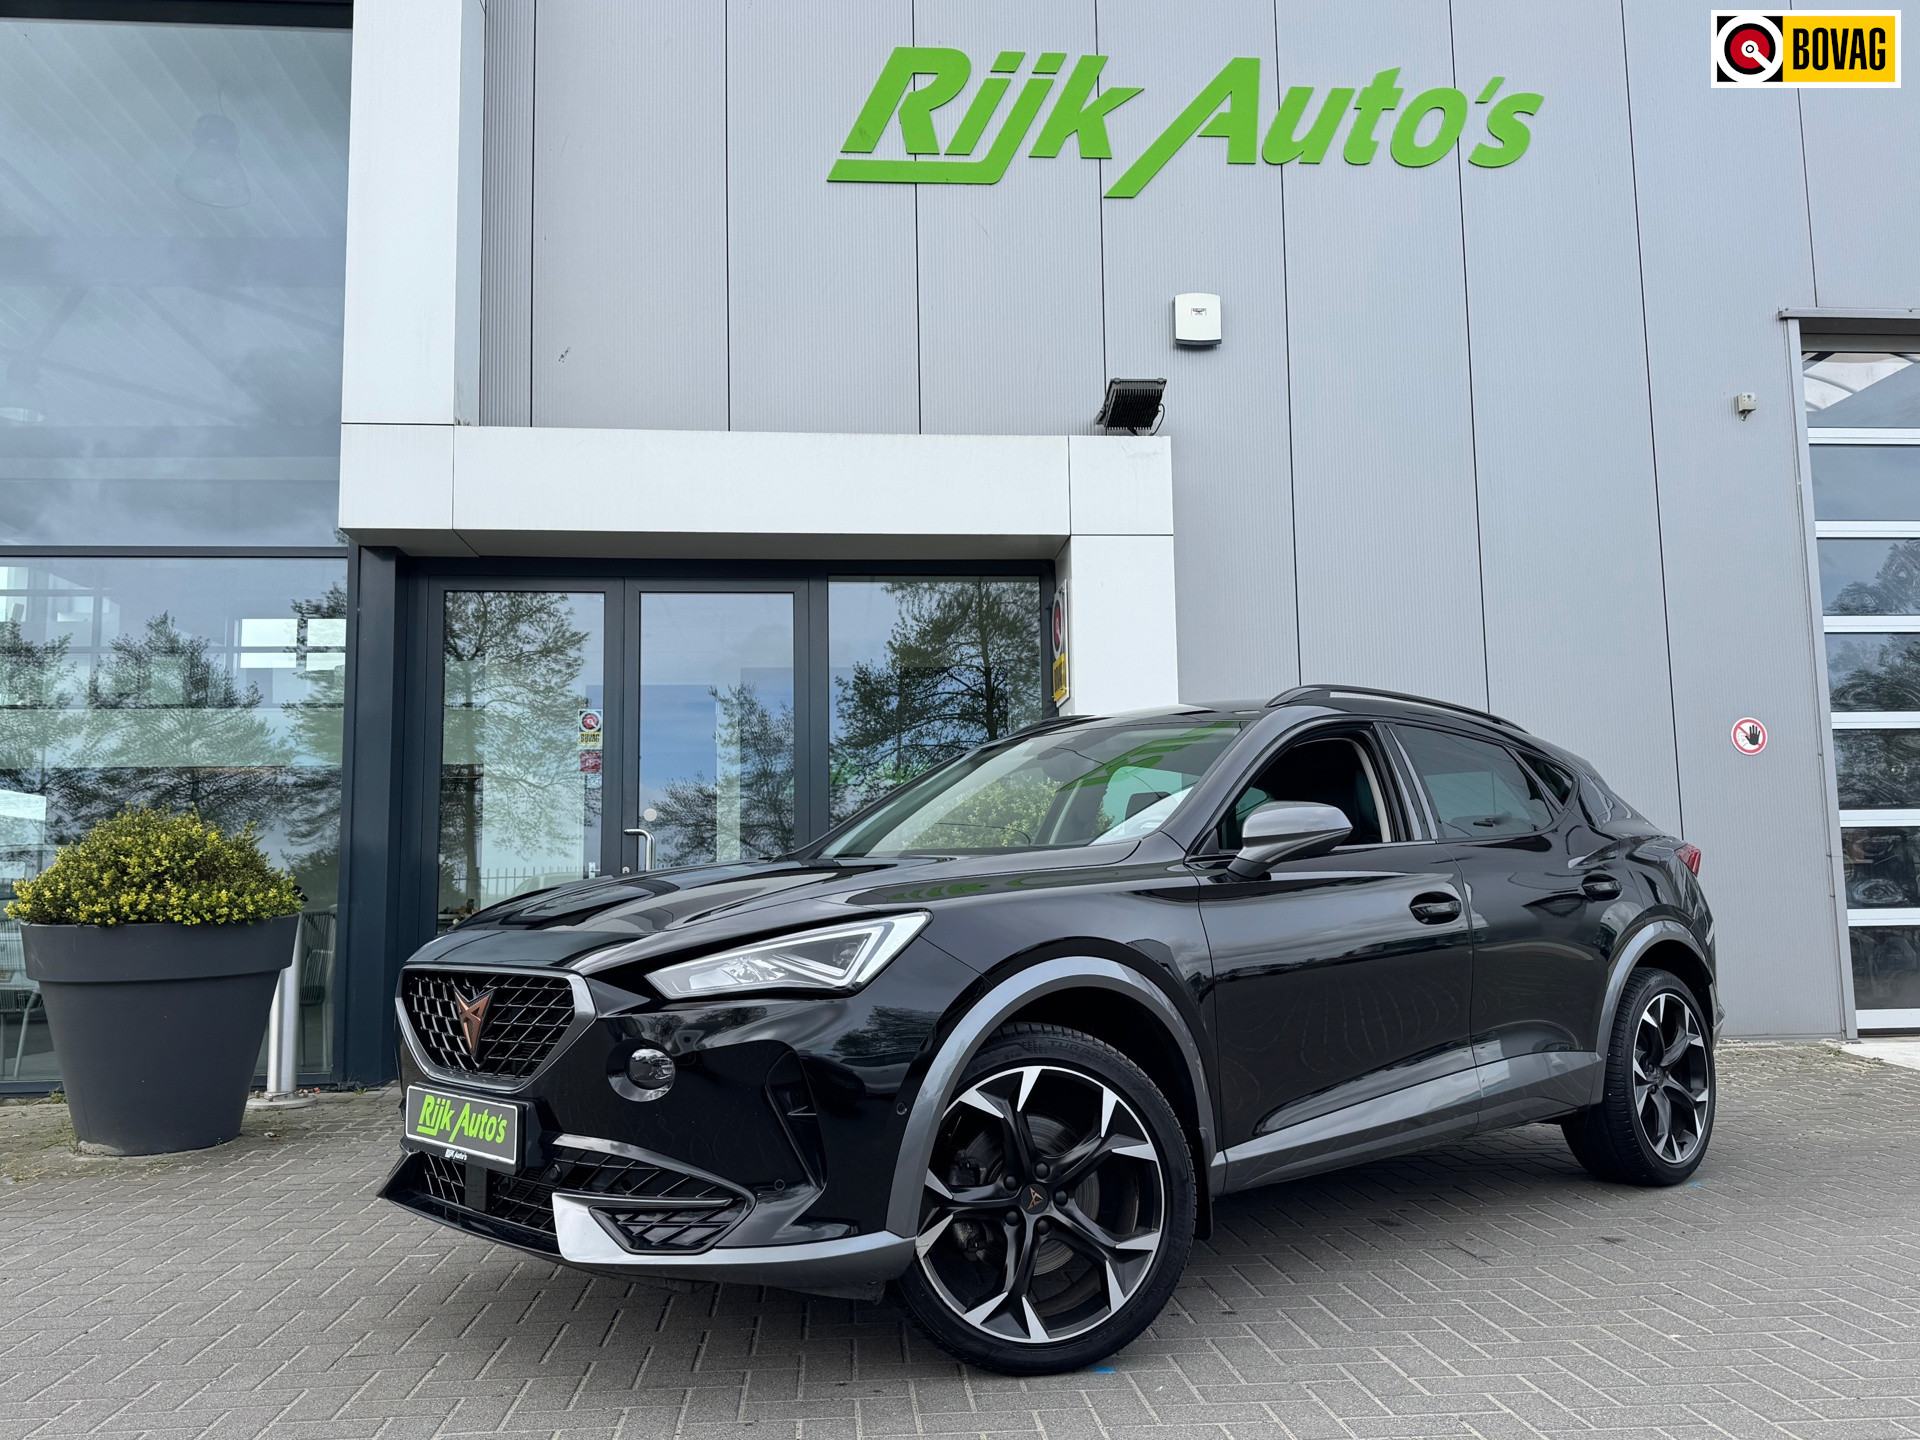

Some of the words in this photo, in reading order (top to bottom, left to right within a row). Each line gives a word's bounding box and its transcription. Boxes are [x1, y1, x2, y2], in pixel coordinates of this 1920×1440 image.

[828, 47, 1144, 185] Rijk
[1104, 57, 1545, 199] Auto's
[416, 1094, 456, 1137] Rijk
[448, 1102, 508, 1144] Auto's
